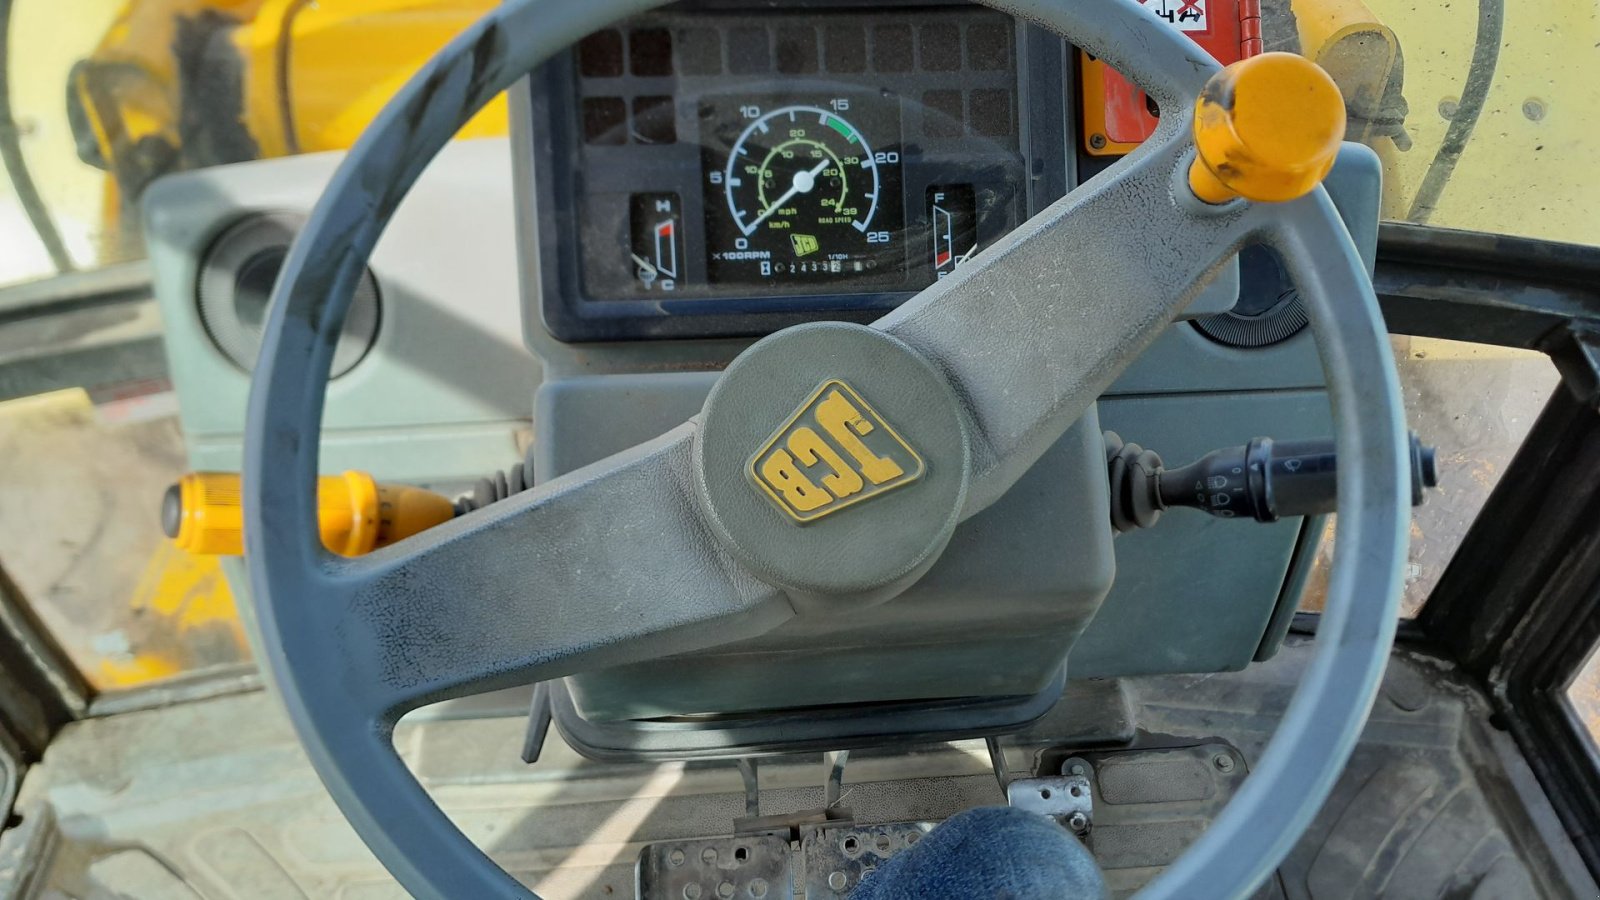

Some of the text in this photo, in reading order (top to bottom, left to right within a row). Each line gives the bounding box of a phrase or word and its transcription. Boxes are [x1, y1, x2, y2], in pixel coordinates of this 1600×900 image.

[830, 99, 849, 111] 15
[740, 106, 760, 118] 10
[781, 151, 794, 159] 10
[810, 150, 823, 158] 15
[875, 152, 898, 163] 20
[844, 157, 859, 165] 30
[745, 166, 758, 174] 10
[823, 168, 838, 176] 20
[710, 171, 722, 183] 5
[820, 198, 836, 206] 24
[934, 192, 945, 203] F
[656, 200, 671, 212] H
[778, 207, 797, 215] mph
[842, 207, 857, 215] 39
[768, 221, 790, 229] km/h
[866, 231, 890, 243] 25
[735, 238, 748, 250] 0
[761, 389, 904, 512] JCB
